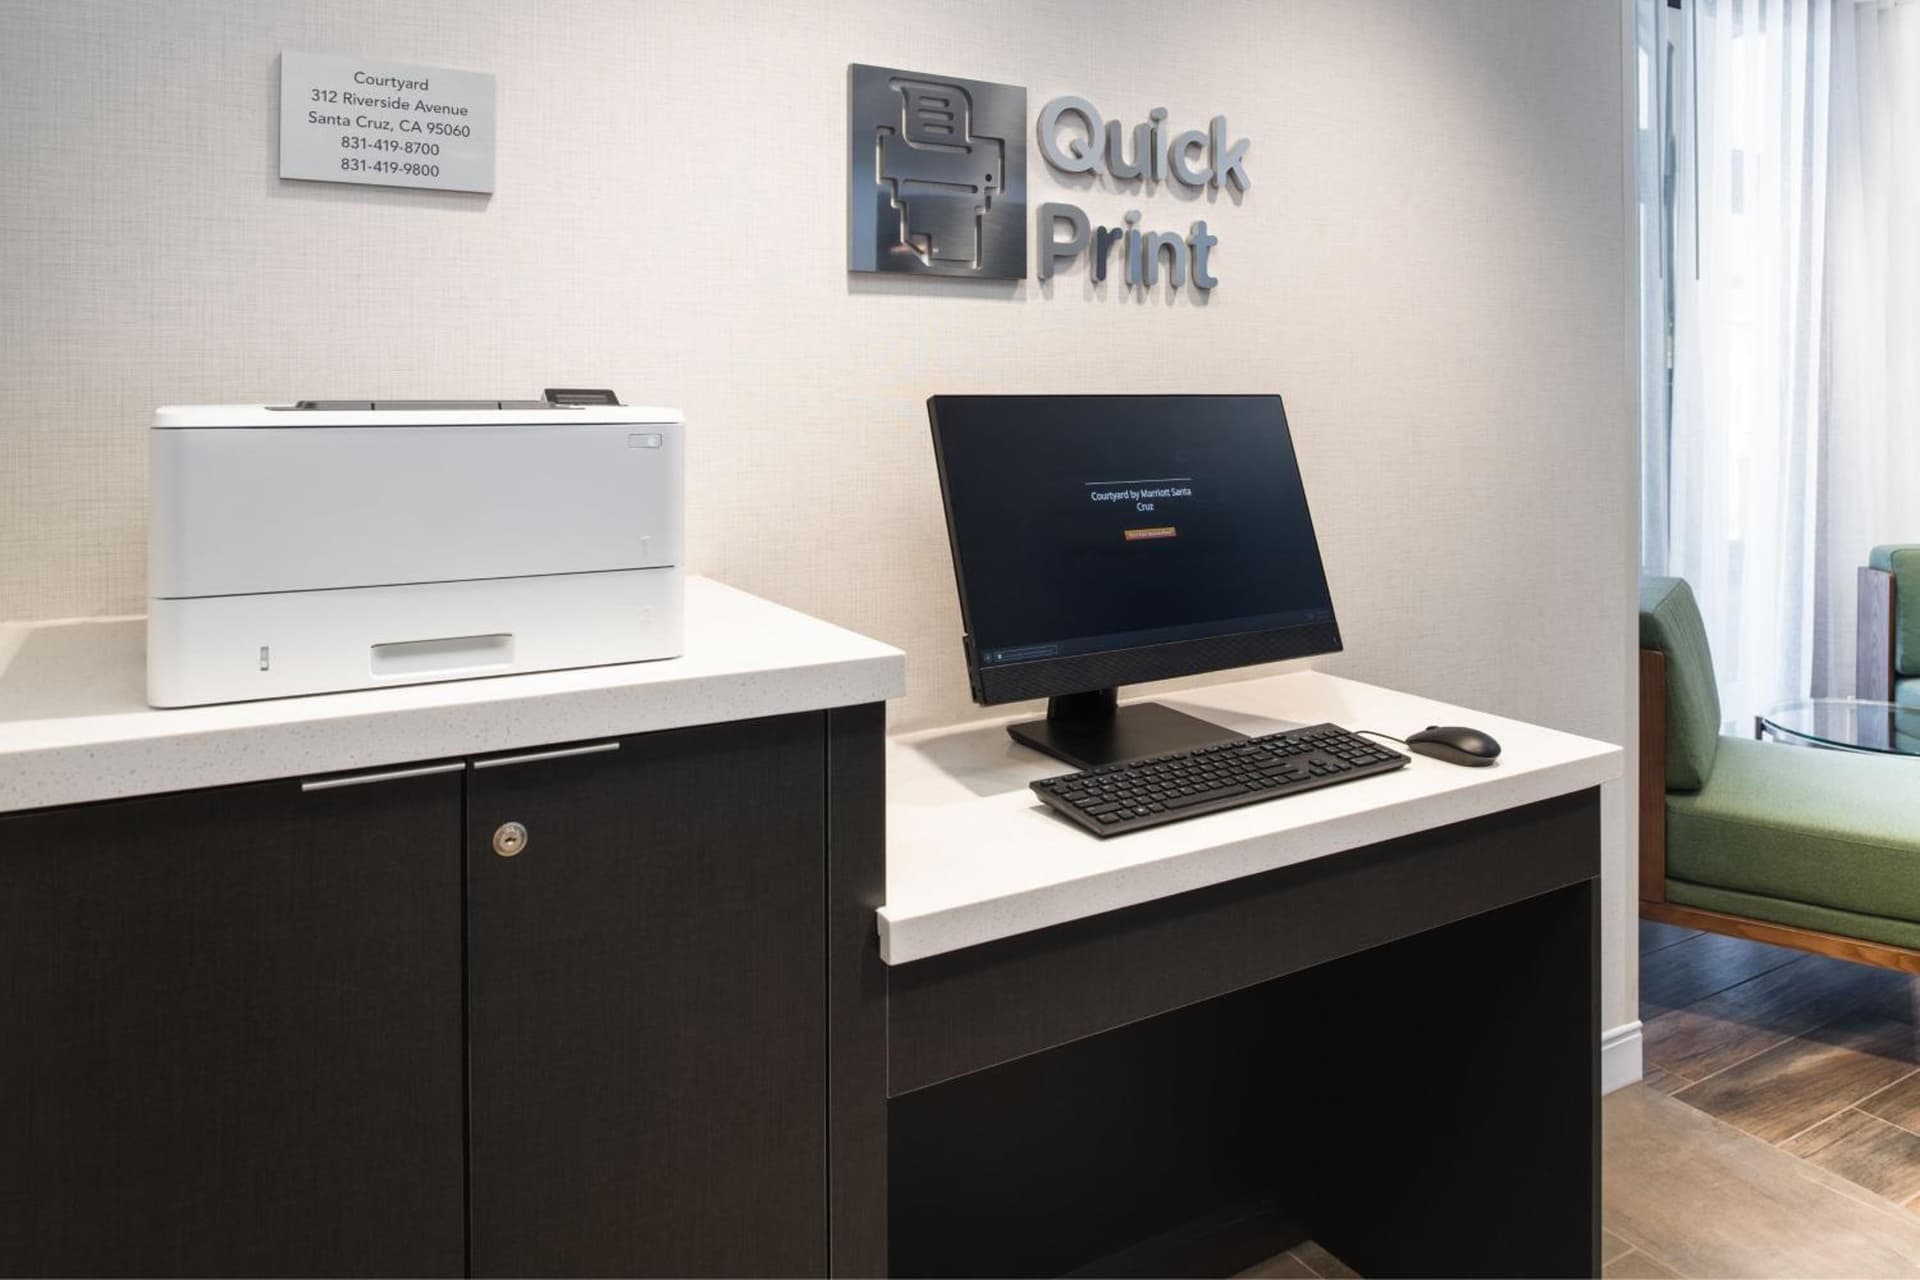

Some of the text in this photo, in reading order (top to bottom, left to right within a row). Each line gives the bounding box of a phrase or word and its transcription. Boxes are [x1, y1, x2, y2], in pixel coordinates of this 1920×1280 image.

[354, 71, 429, 91] Courtyard
[311, 89, 469, 116] 312 Riverside Avenue
[308, 111, 470, 138] Santa Cruz, CA 95060
[341, 136, 440, 156] 831-419-8700
[1037, 96, 1251, 192] Quick
[341, 158, 440, 177] 831-419-9800
[1037, 202, 1218, 290] Print
[1091, 488, 1192, 502] Courtyard by Marriott Santa
[1136, 502, 1154, 511] Cruz
